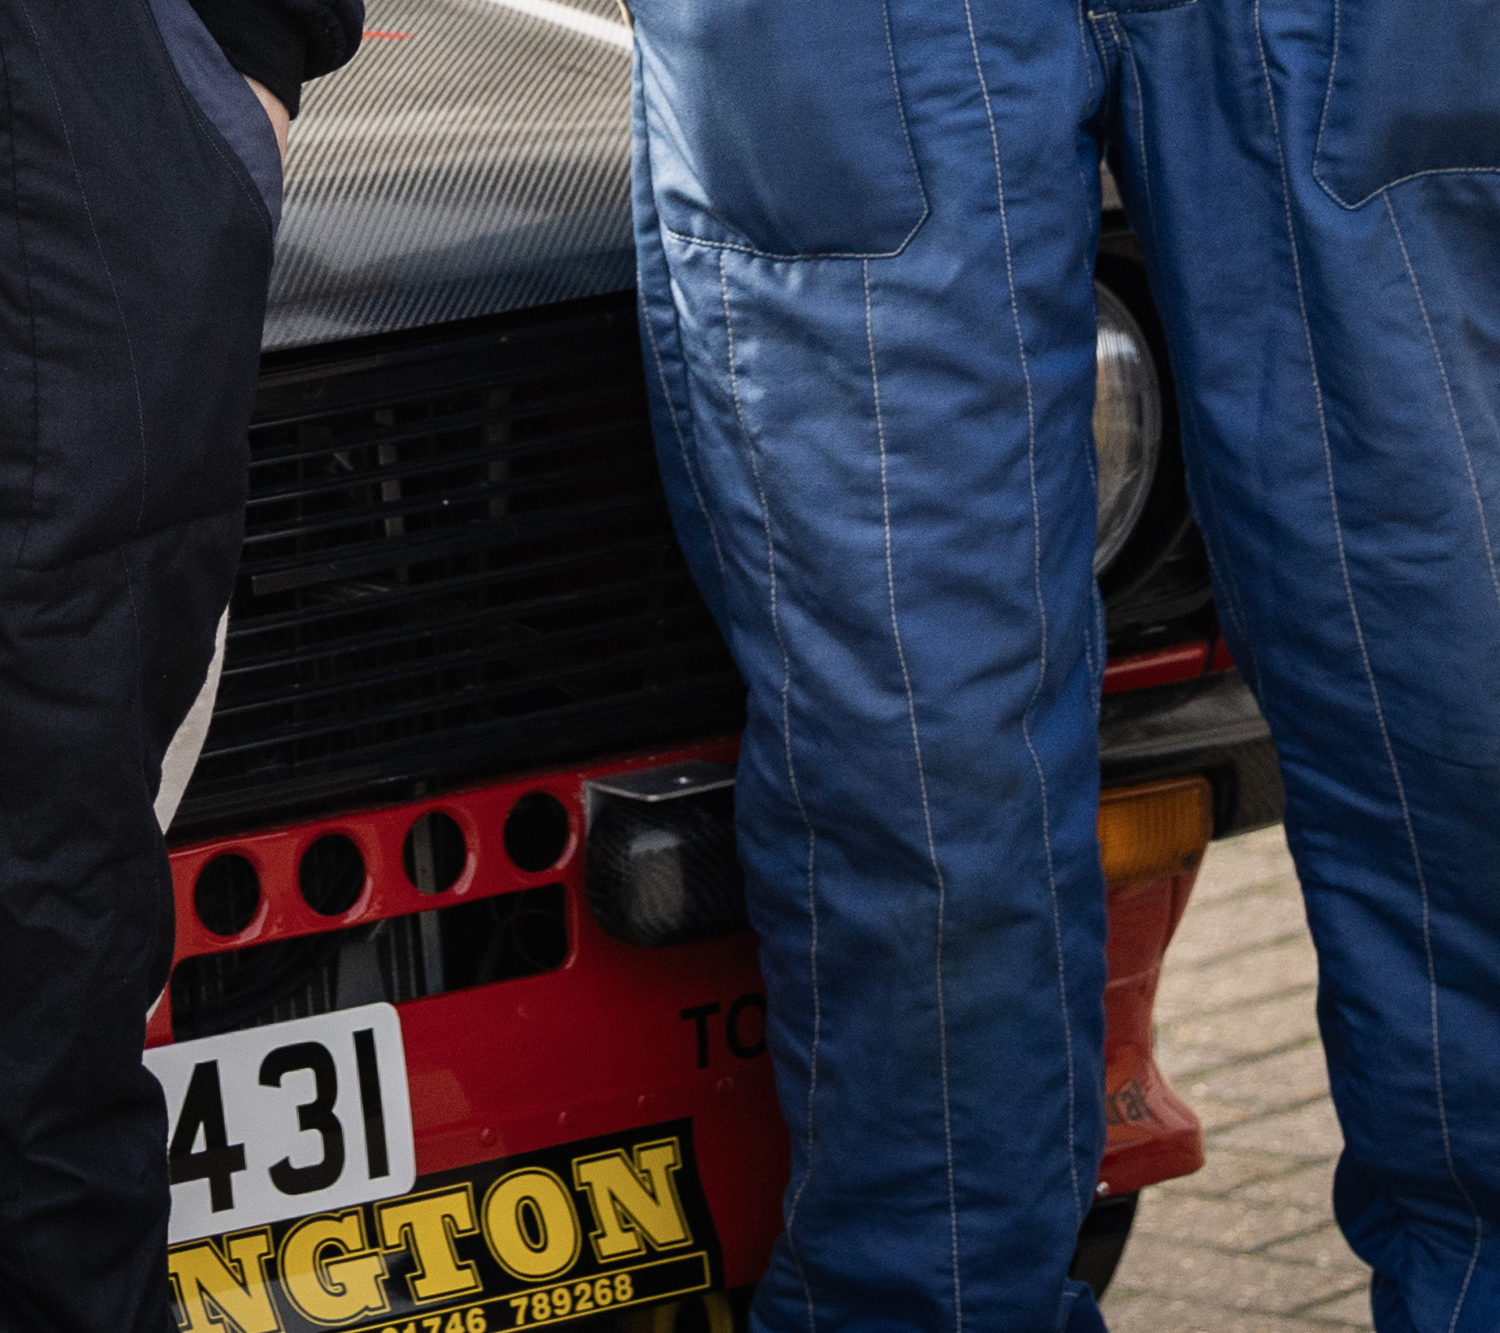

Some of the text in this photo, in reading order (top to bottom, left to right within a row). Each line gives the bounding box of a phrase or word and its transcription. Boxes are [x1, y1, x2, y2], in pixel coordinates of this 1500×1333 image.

[168, 1027, 390, 1214] 431
[381, 1273, 634, 1333] 1746 789268
